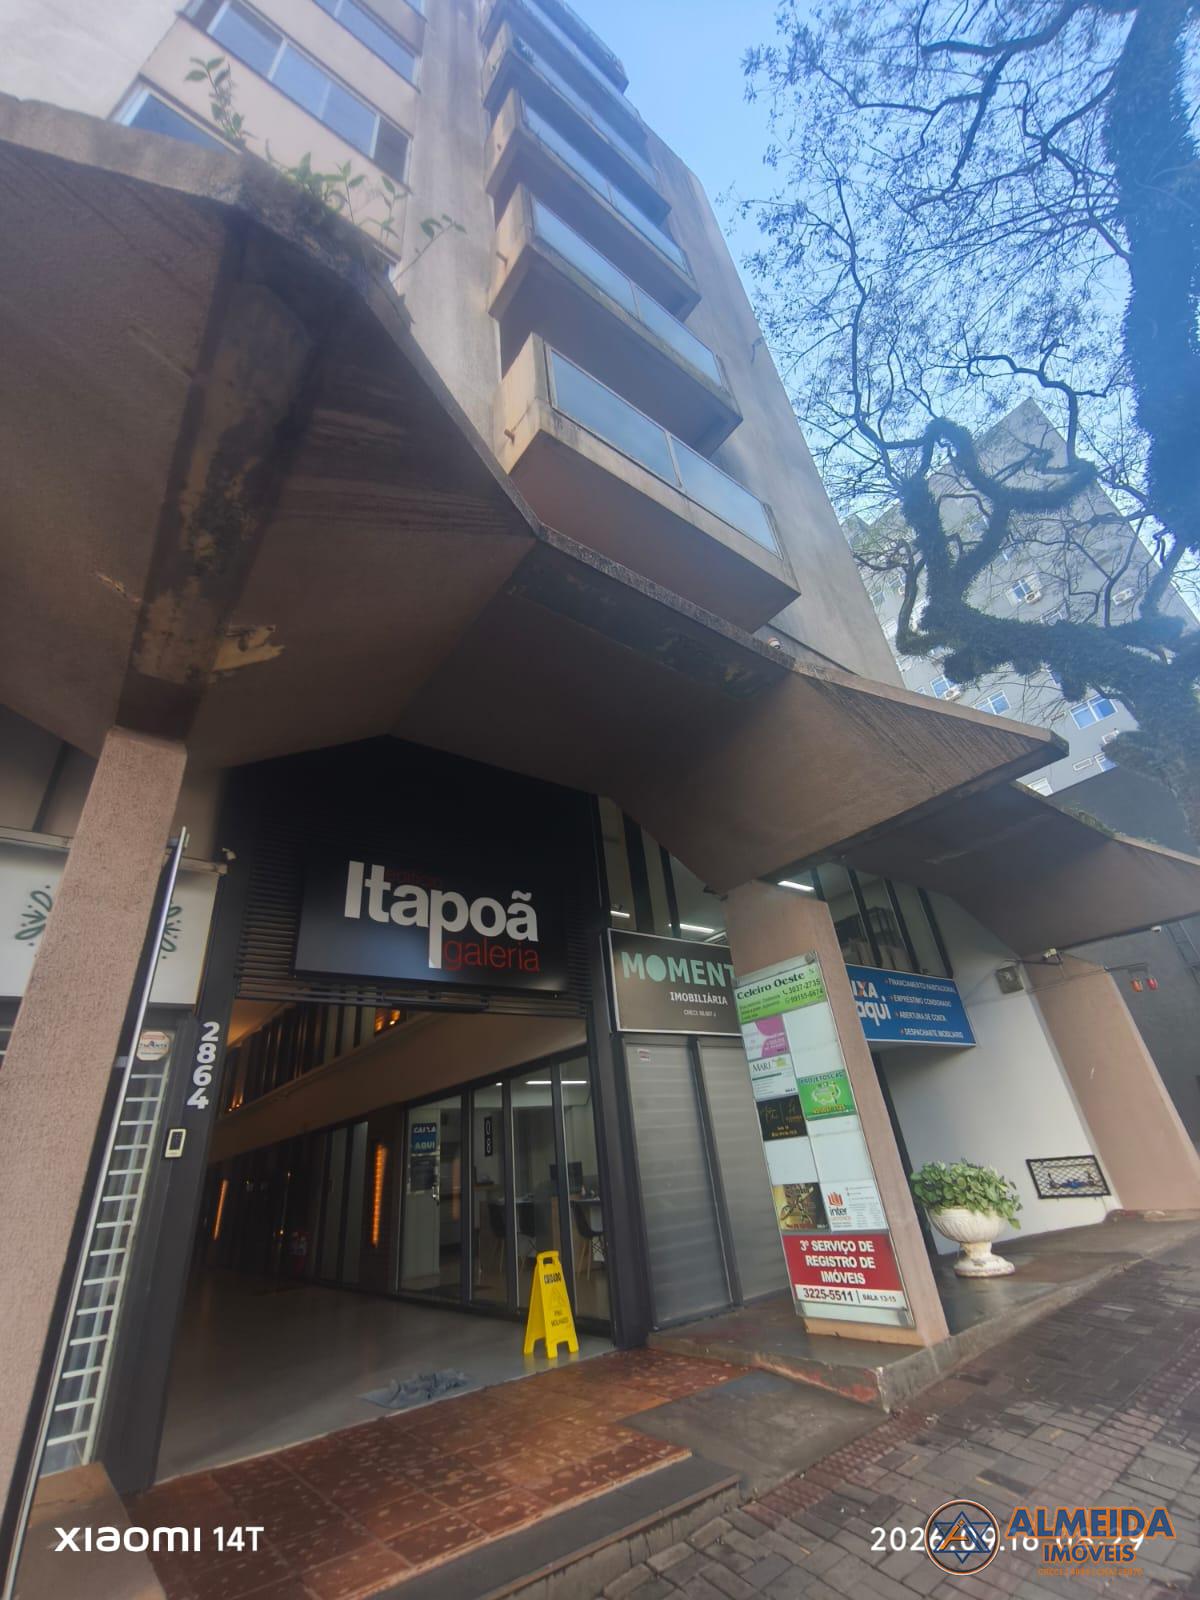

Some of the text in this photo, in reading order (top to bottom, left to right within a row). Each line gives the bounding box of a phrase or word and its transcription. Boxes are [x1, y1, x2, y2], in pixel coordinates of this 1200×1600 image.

[344, 860, 539, 969] Itapoã
[444, 938, 540, 971] galeria
[736, 971, 806, 1000] Celeiro Oeste
[670, 991, 728, 1005] IMOBILIÁRIA
[186, 1021, 220, 1110] 2864
[413, 1125, 436, 1134] CAIXA
[415, 1141, 436, 1150] AQUI
[810, 1240, 856, 1255] SERVIÇO
[858, 1241, 875, 1252] DE
[805, 1255, 876, 1269] REGISTRO DE
[820, 1269, 866, 1284] IMÓVEIS
[802, 1287, 854, 1302] 3225-5511
